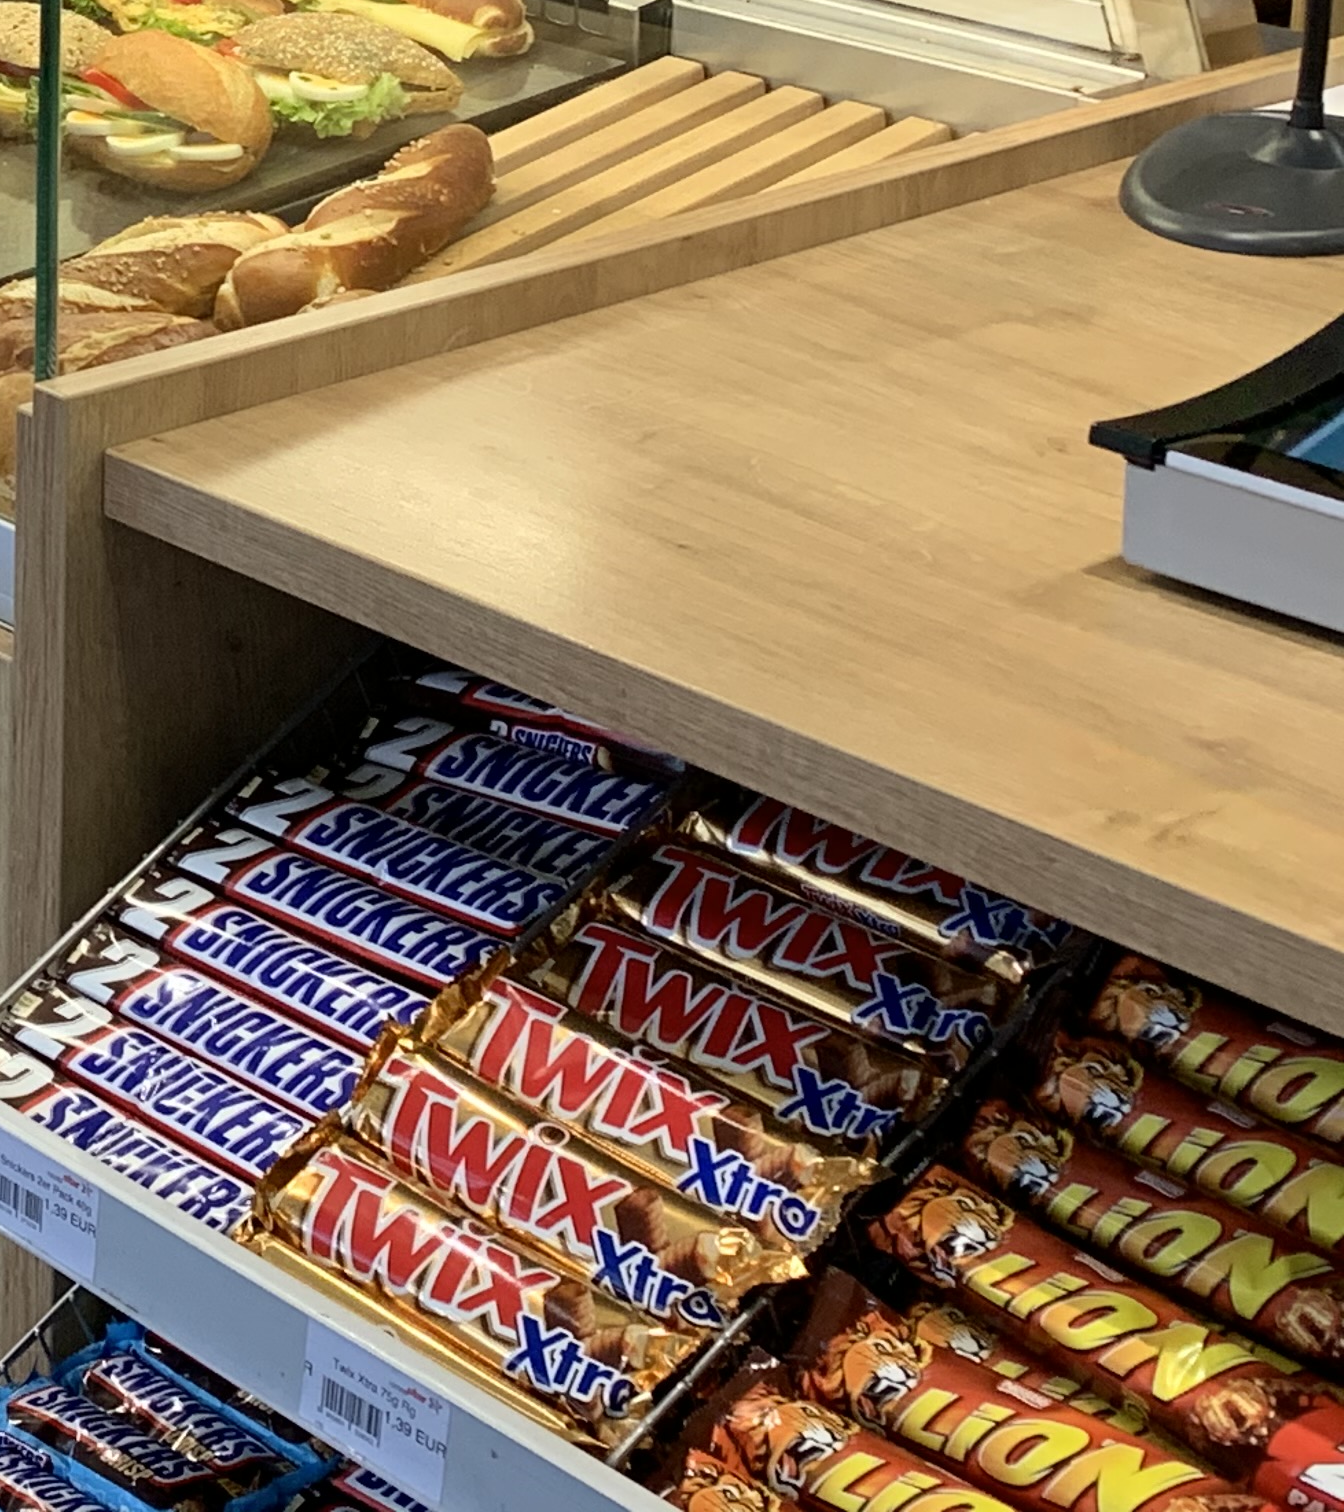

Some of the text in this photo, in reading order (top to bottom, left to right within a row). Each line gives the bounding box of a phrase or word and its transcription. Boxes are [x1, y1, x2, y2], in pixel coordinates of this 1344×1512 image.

[366, 717, 455, 773] 2
[174, 828, 272, 888] 2
[238, 776, 568, 924] 2 SNICKERS
[119, 877, 215, 939] 2
[67, 938, 362, 1113] 2 SNICKERS
[13, 996, 306, 1172] 2 SNICKER
[0, 1152, 36, 1182] Snickers
[675, 1138, 821, 1240] Xtra
[70, 1212, 97, 1239] EUR
[1045, 1181, 1335, 1322] LION
[590, 1230, 725, 1330] Xtra
[961, 1252, 1264, 1403] LION
[106, 1356, 268, 1467] SNICKERS
[333, 1356, 355, 1380] Twix
[357, 1372, 378, 1395] Xtra
[25, 1386, 202, 1483] SNICKERS
[415, 1428, 448, 1459] EUR
[892, 1386, 1209, 1512] LION
